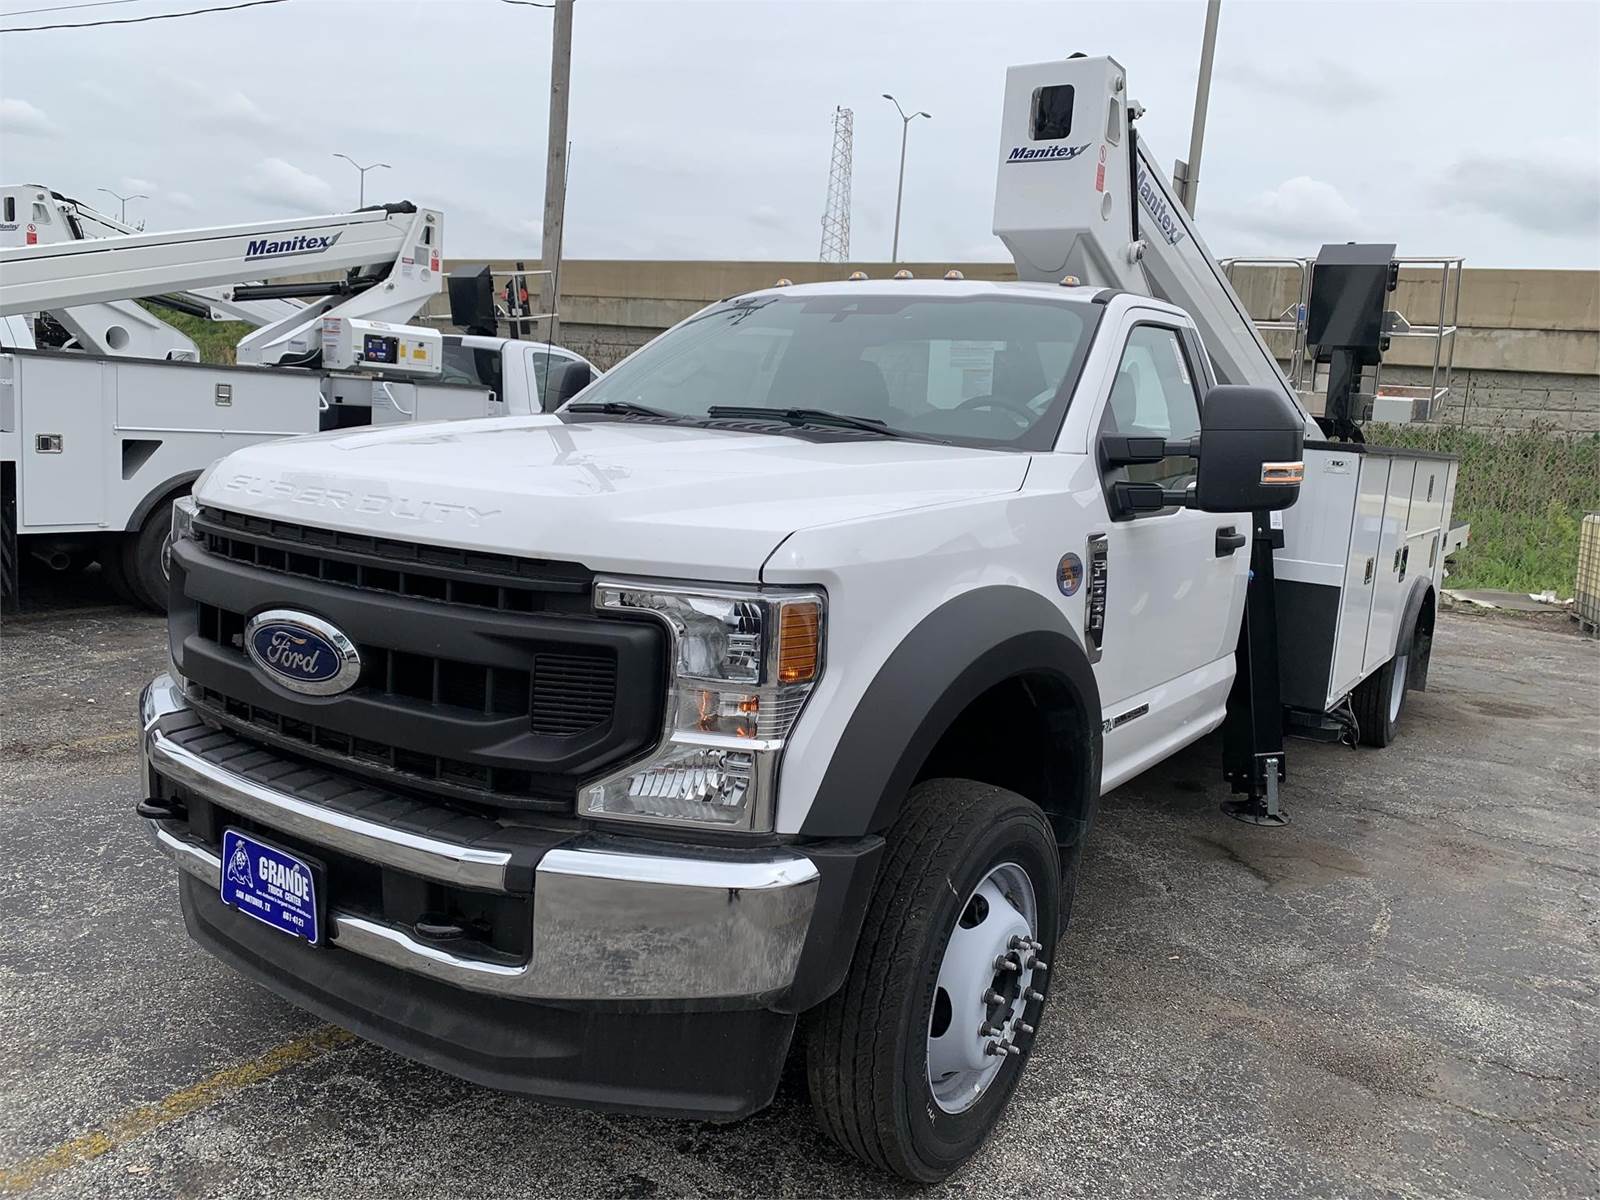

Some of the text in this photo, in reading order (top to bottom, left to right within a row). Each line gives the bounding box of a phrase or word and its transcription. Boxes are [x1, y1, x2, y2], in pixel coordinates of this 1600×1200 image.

[1009, 145, 1079, 160] Manitex
[246, 235, 330, 256] Manitex
[224, 475, 502, 527] SUPER DUTY
[267, 631, 320, 673] Ford
[259, 856, 310, 902] GRANDE
[235, 889, 245, 900] SAN
[264, 902, 271, 912] TX
[267, 883, 302, 907] TRUCK CENTER
